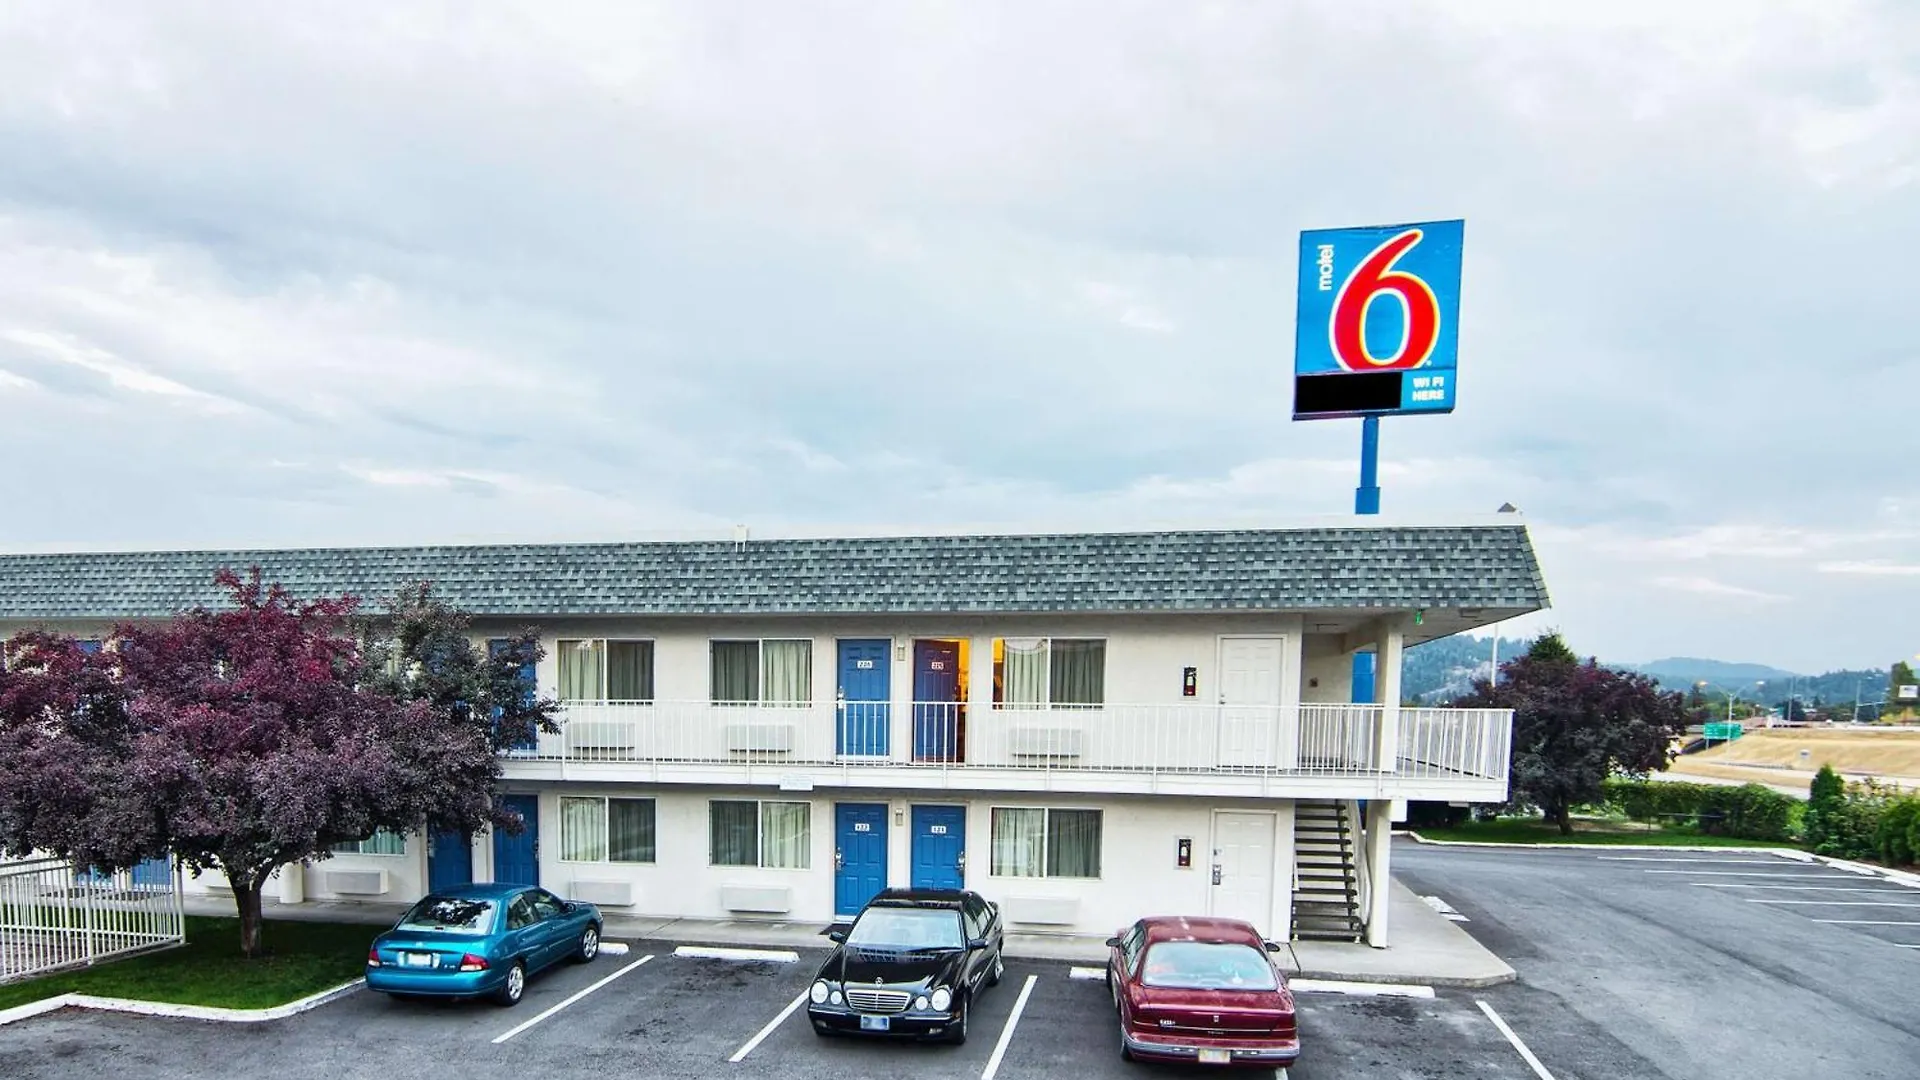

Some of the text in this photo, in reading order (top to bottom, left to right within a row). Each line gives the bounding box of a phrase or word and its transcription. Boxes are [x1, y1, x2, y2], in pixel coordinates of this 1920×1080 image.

[1317, 244, 1334, 291] motel
[1328, 228, 1441, 372] 6
[1412, 389, 1445, 402] HERE
